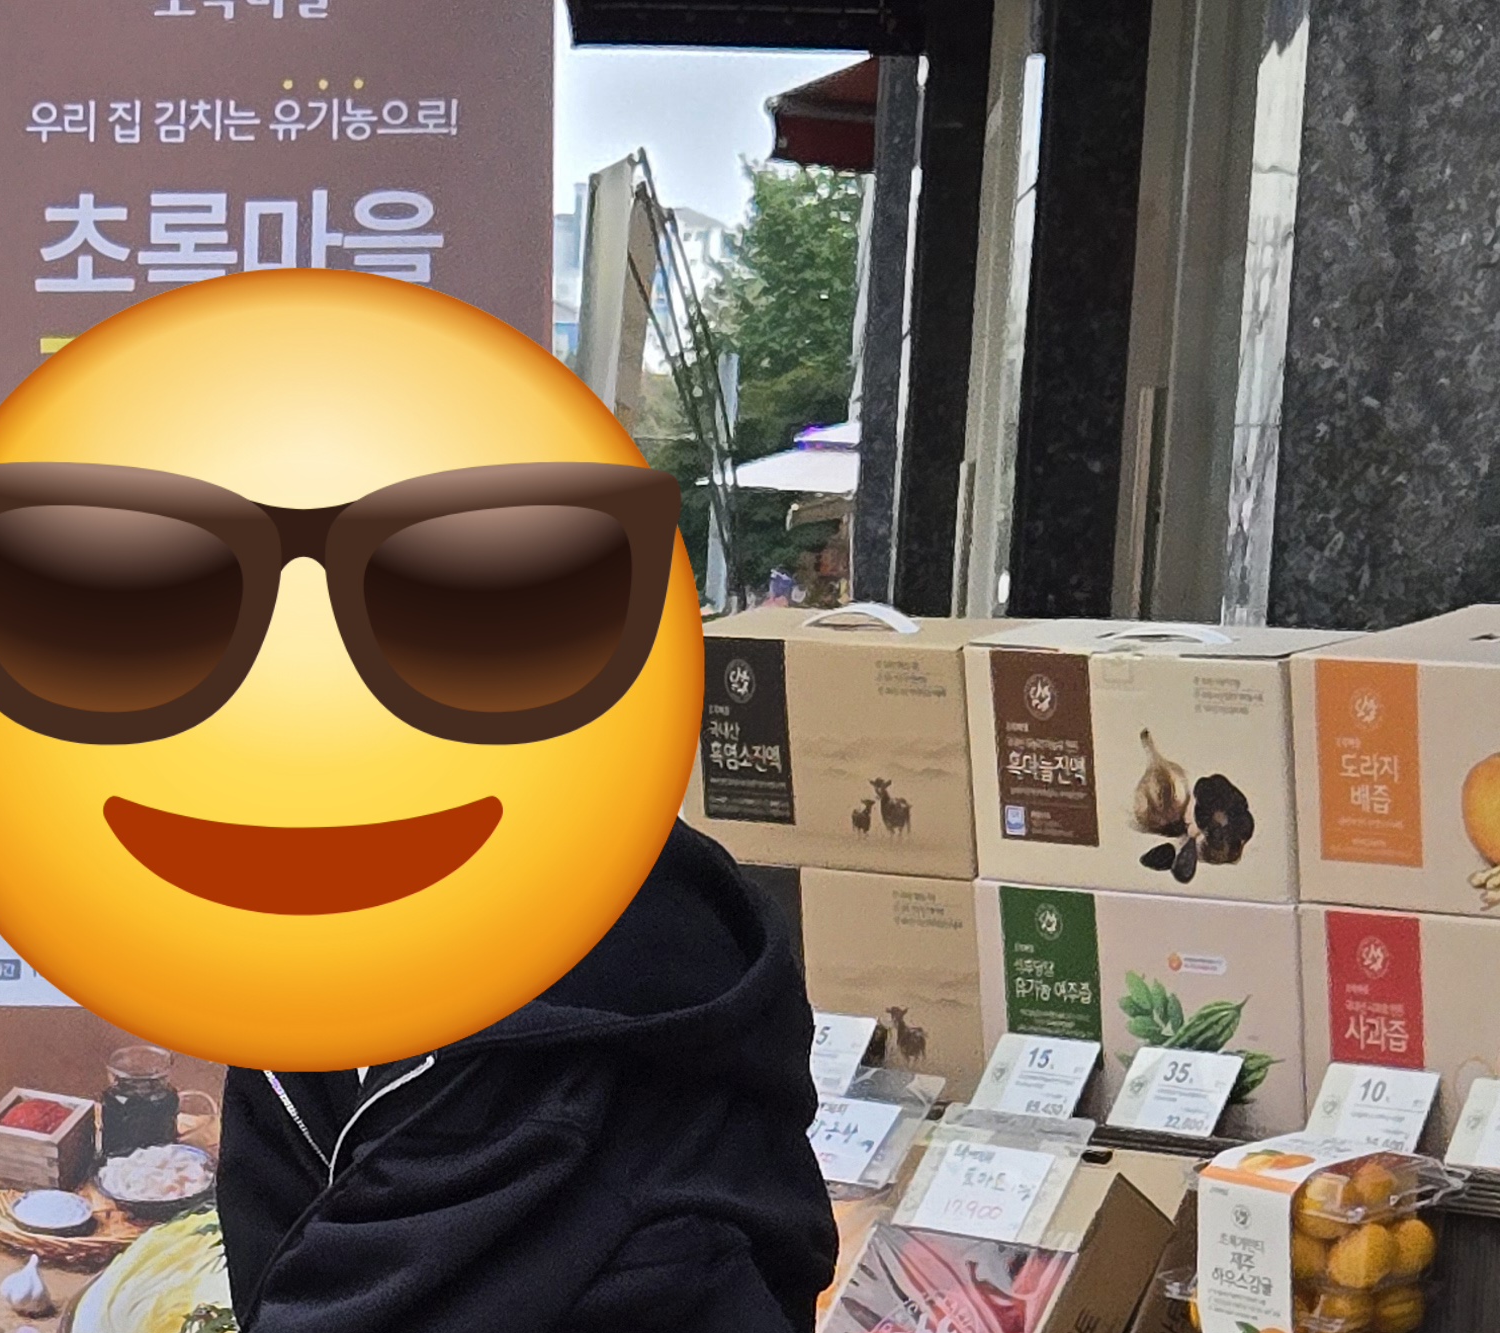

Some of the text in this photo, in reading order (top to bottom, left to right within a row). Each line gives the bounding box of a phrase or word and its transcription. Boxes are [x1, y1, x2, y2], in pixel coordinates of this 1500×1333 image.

[26, 98, 459, 143] 우리 집 김치는 유기농으로!
[34, 188, 445, 292] 초록마을
[708, 721, 741, 742] 국내산
[709, 740, 783, 774] 흑염소진액
[1339, 752, 1400, 783] 도라지
[1349, 783, 1392, 816] 배즙
[1014, 976, 1093, 1005] 유기농 여주즙
[1344, 1013, 1410, 1053] 사과즙
[1229, 1251, 1256, 1272] 제주
[1211, 1266, 1274, 1297] 하우스감귤
